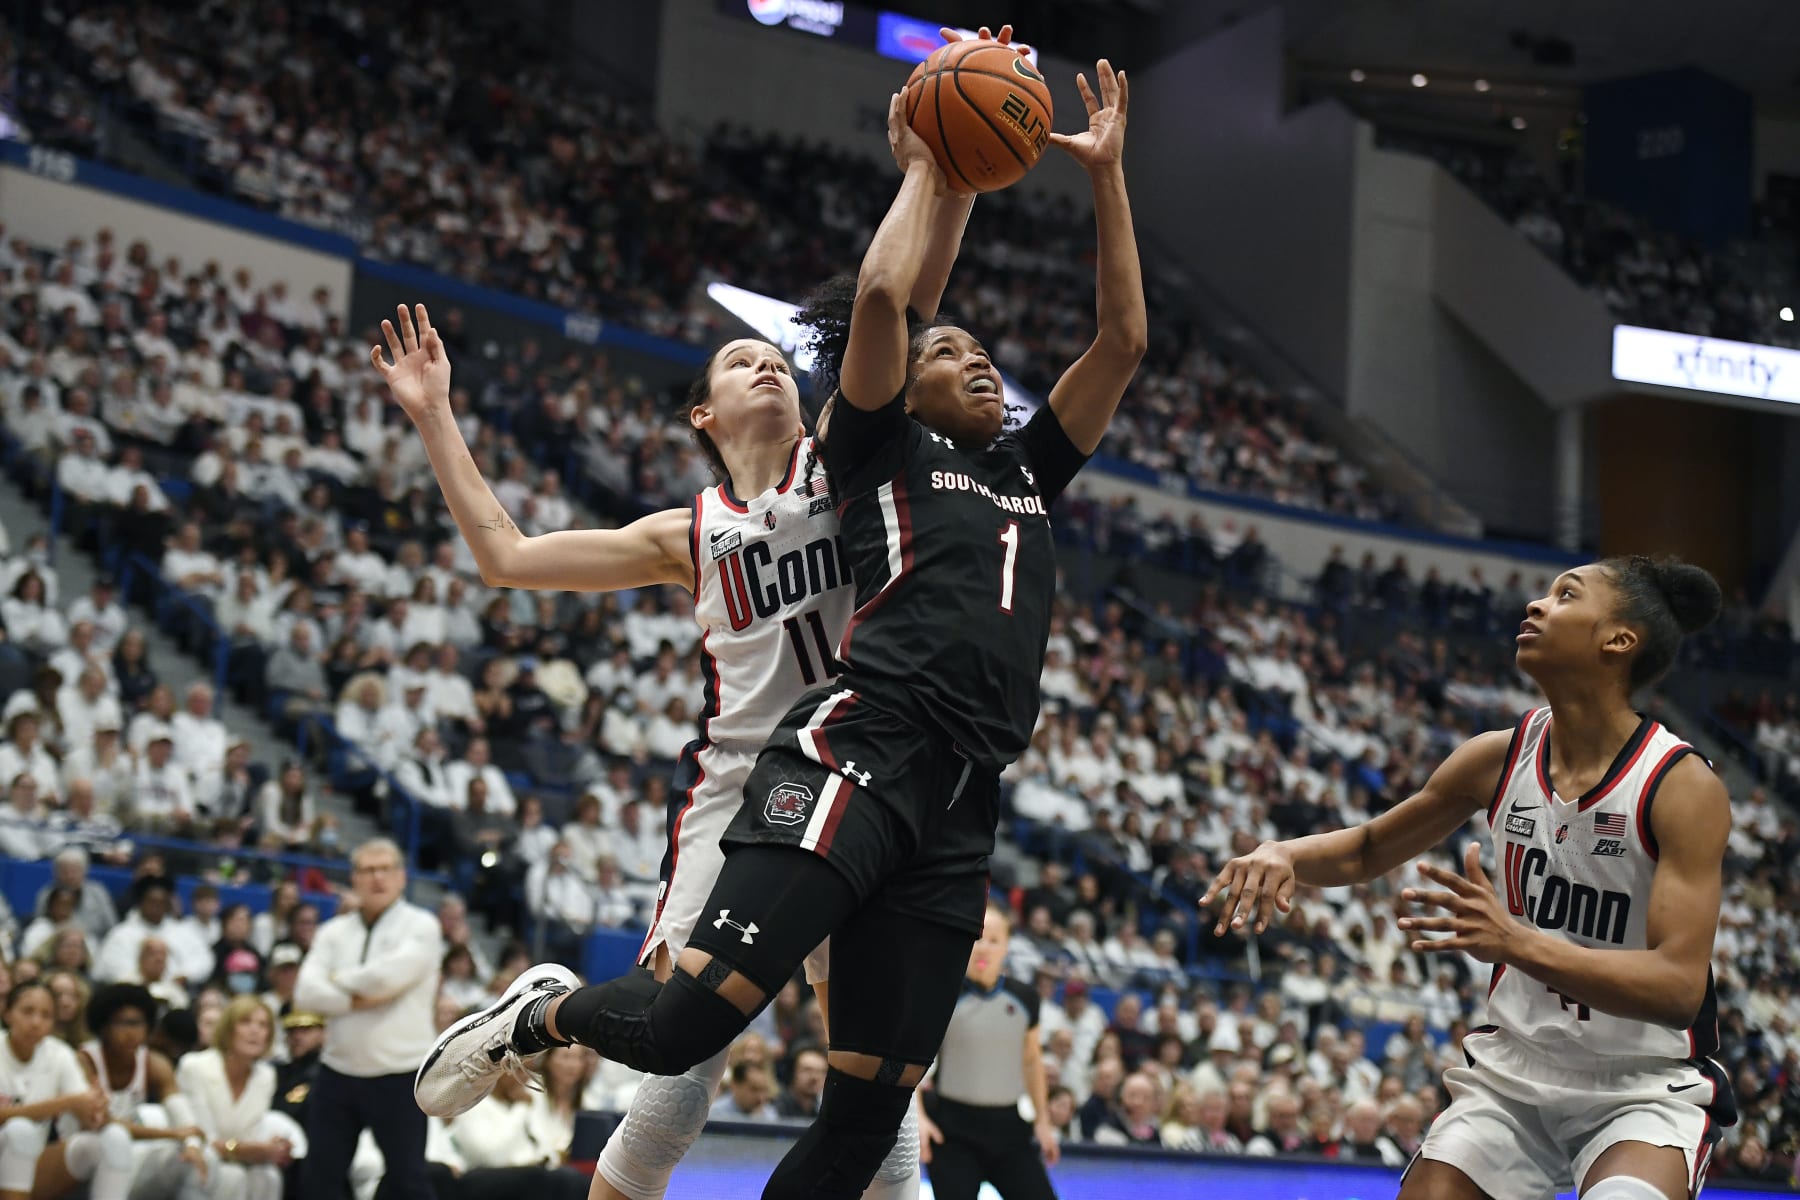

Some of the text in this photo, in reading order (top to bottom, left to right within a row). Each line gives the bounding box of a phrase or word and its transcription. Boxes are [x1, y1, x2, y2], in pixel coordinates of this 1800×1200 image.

[931, 470, 993, 499] SOUTH
[992, 493, 1048, 518] CAROL
[998, 518, 1020, 616] 1
[783, 610, 839, 686] 11
[1592, 846, 1627, 856] EAST
[1597, 839, 1621, 847] BIG
[1505, 841, 1632, 944] UConn
